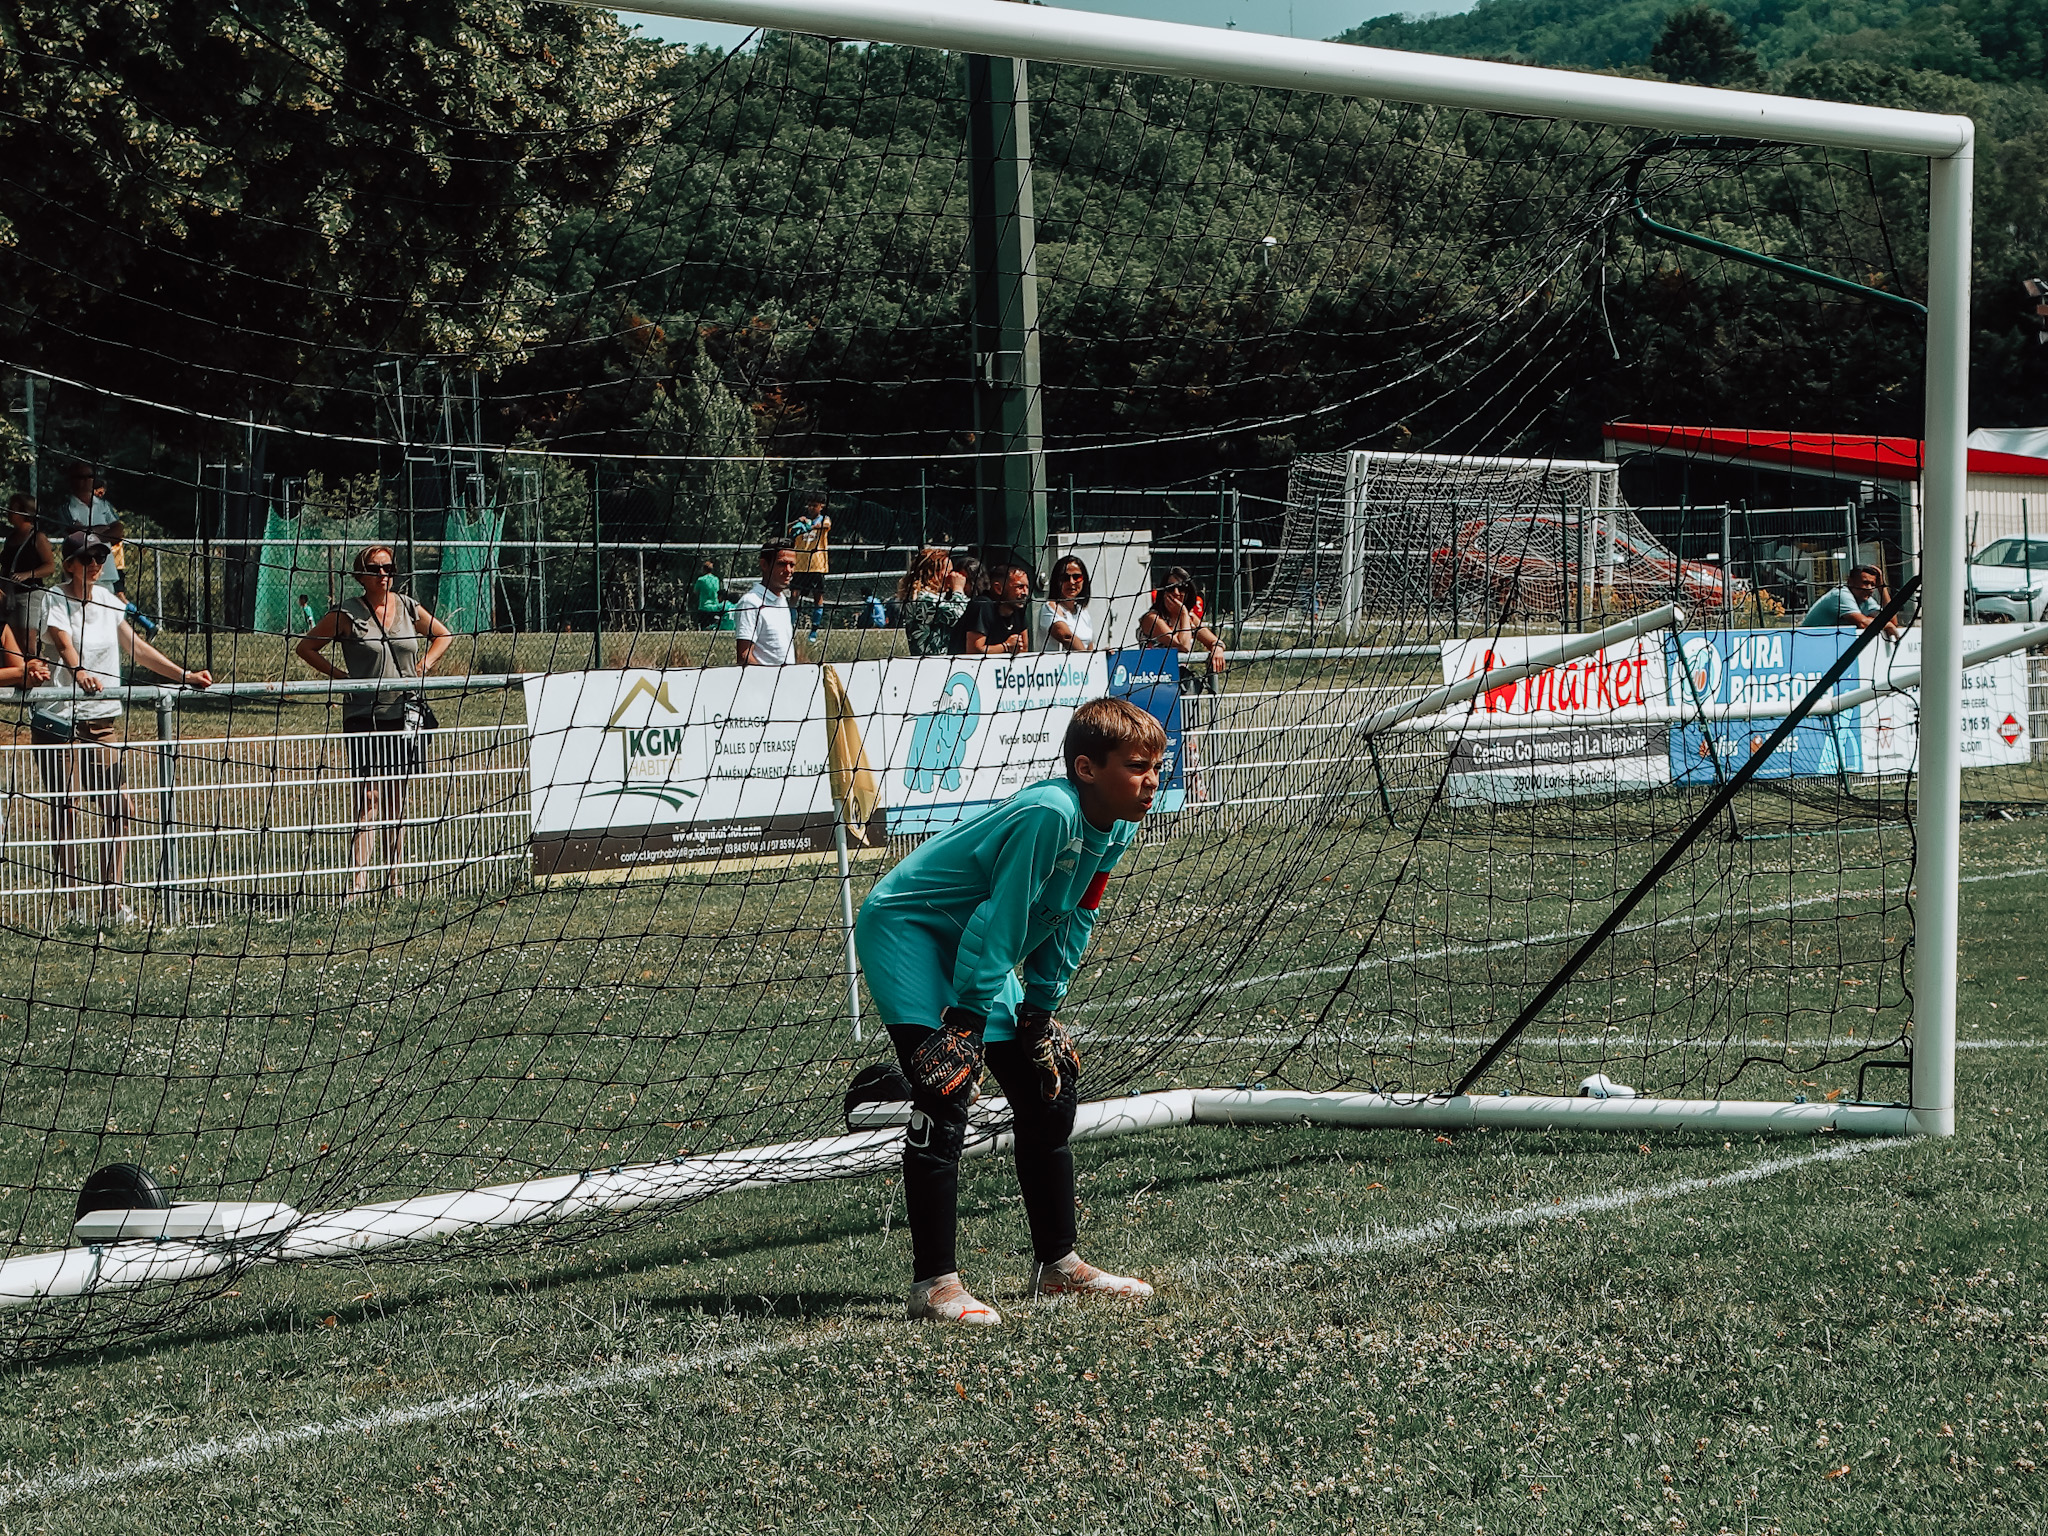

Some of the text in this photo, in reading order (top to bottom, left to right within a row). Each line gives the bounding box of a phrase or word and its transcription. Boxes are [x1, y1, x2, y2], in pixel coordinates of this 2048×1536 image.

[1729, 635, 1784, 670] JURA
[1524, 643, 1648, 714] market
[629, 728, 682, 757] KGM
[715, 739, 746, 755] DALLES
[763, 740, 796, 754] TERASSE
[999, 734, 1021, 746] Victor
[1472, 741, 1514, 765] Centre
[1514, 735, 1584, 761] Commercal
[1585, 734, 1600, 755] La
[629, 758, 683, 777] HABITAT
